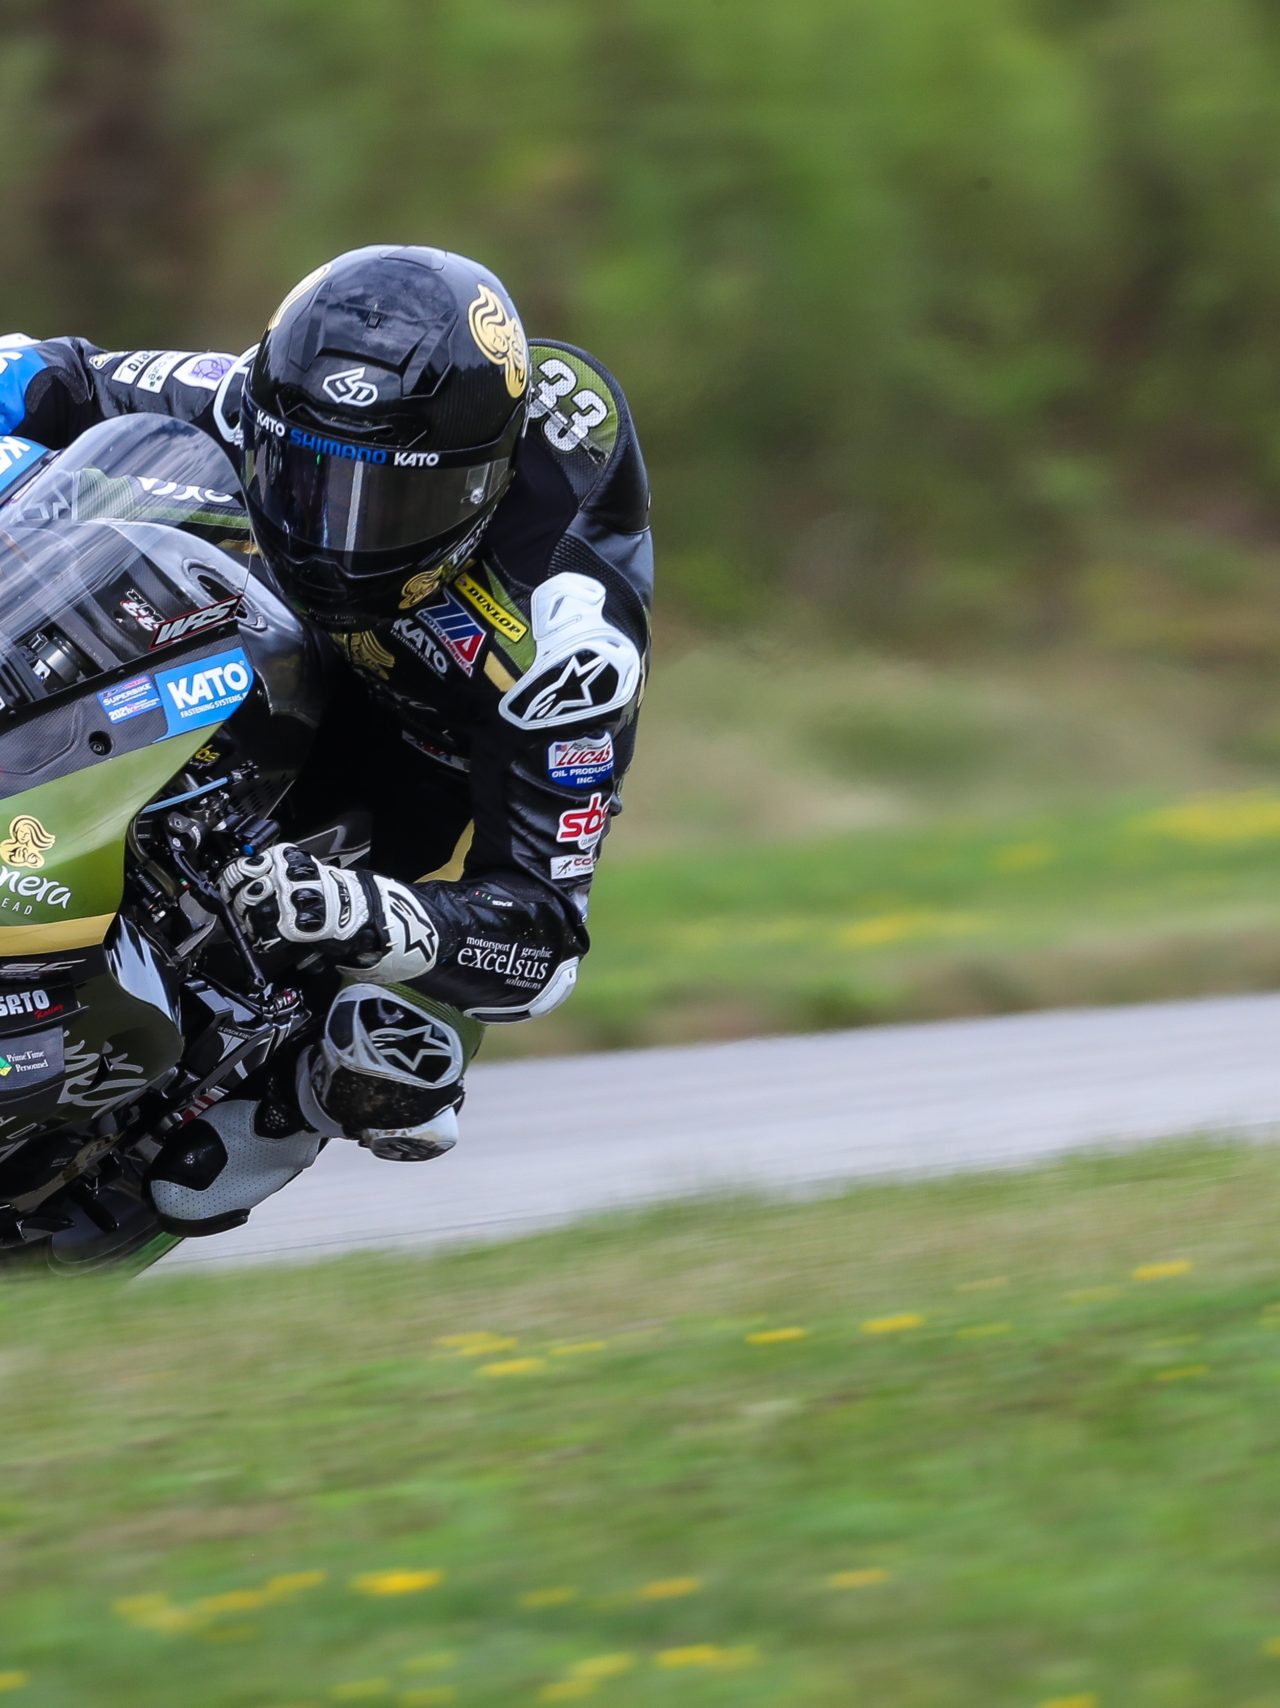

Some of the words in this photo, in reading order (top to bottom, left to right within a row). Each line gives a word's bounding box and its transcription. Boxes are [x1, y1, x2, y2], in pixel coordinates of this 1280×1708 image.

[528, 357, 609, 453] 33
[256, 410, 286, 437] KATO
[393, 452, 440, 467] KATO
[467, 586, 522, 635] DUNLOP
[393, 618, 448, 674] KATO
[167, 662, 248, 710] KATO
[180, 703, 215, 719] FASTENING
[555, 744, 611, 767] LUCAS
[551, 769, 568, 778] OIL
[576, 776, 596, 784] INC.
[466, 936, 511, 952] motorsport
[457, 942, 549, 980] excelsus
[505, 976, 542, 990] solutions
